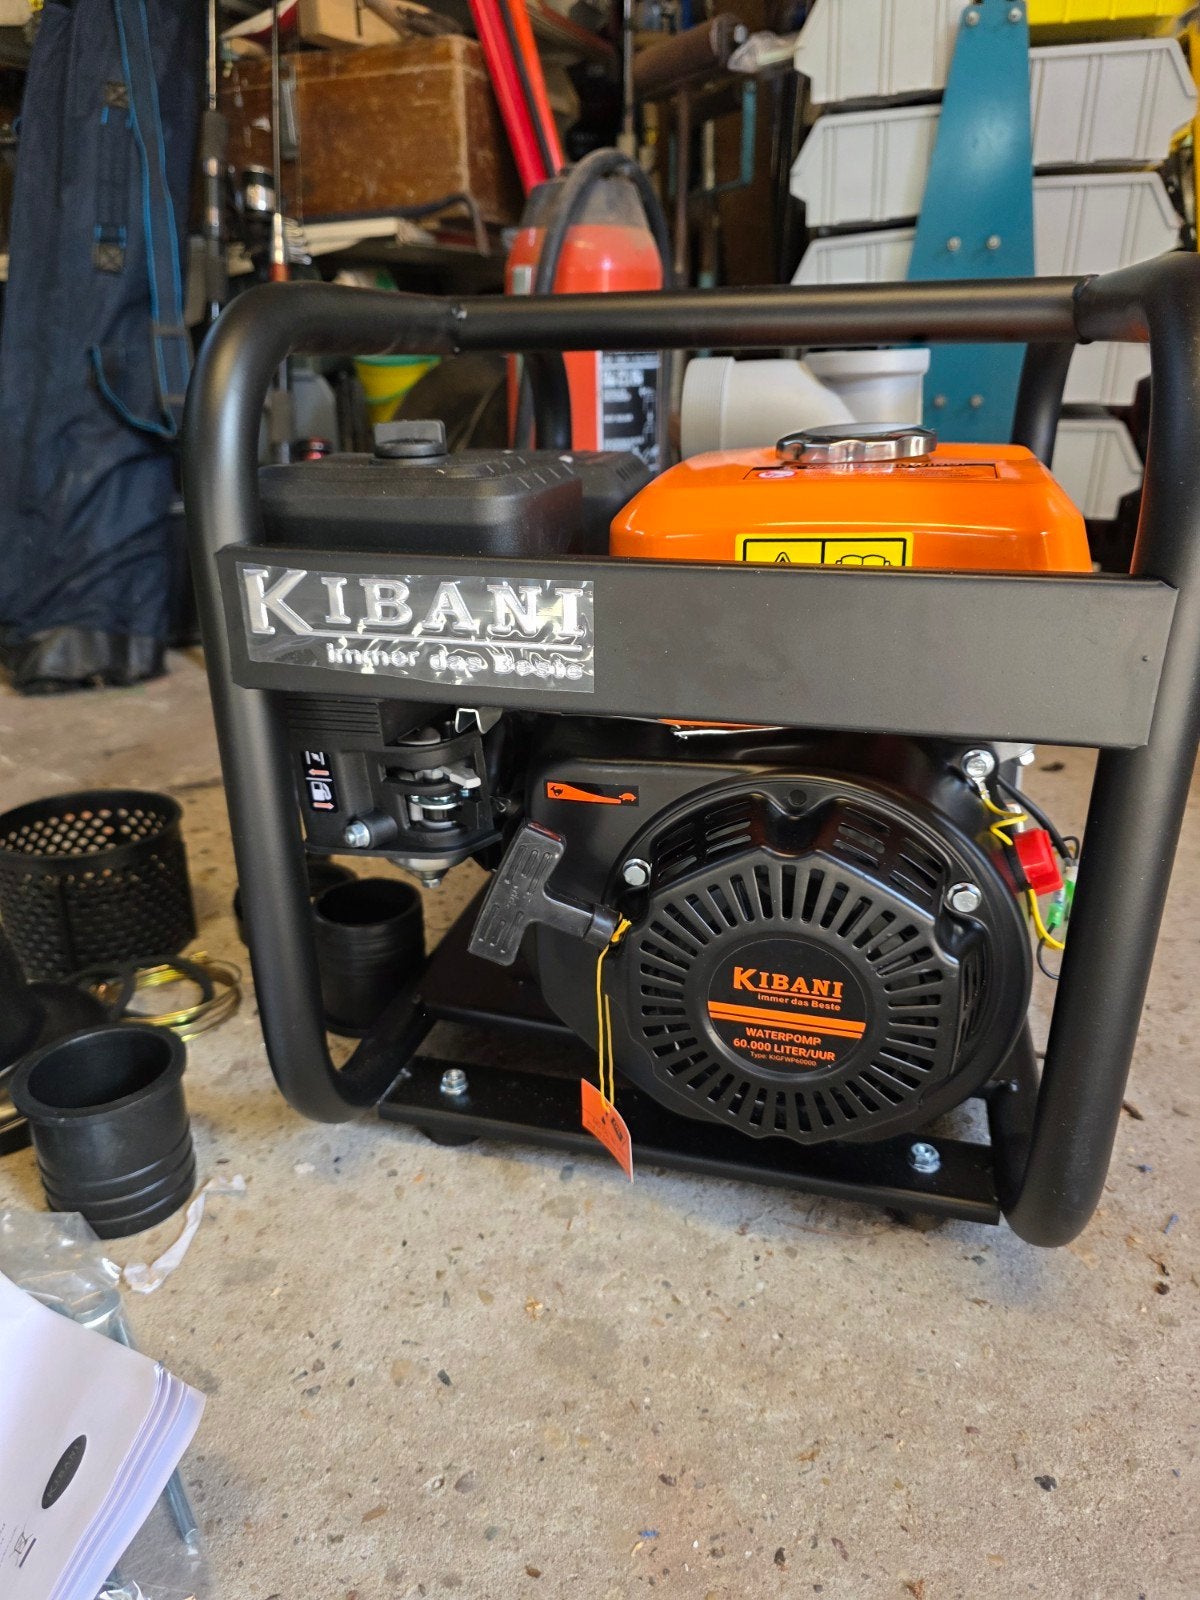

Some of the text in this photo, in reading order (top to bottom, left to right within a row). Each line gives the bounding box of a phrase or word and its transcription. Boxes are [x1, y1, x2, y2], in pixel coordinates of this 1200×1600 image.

[243, 568, 584, 637] KIBANI
[733, 966, 843, 998] KIBANI
[791, 995, 809, 1008] das
[811, 1000, 841, 1012] Beste
[746, 1026, 822, 1046] WATERPOMP
[733, 1037, 836, 1062] 60.000 LITER/UUR
